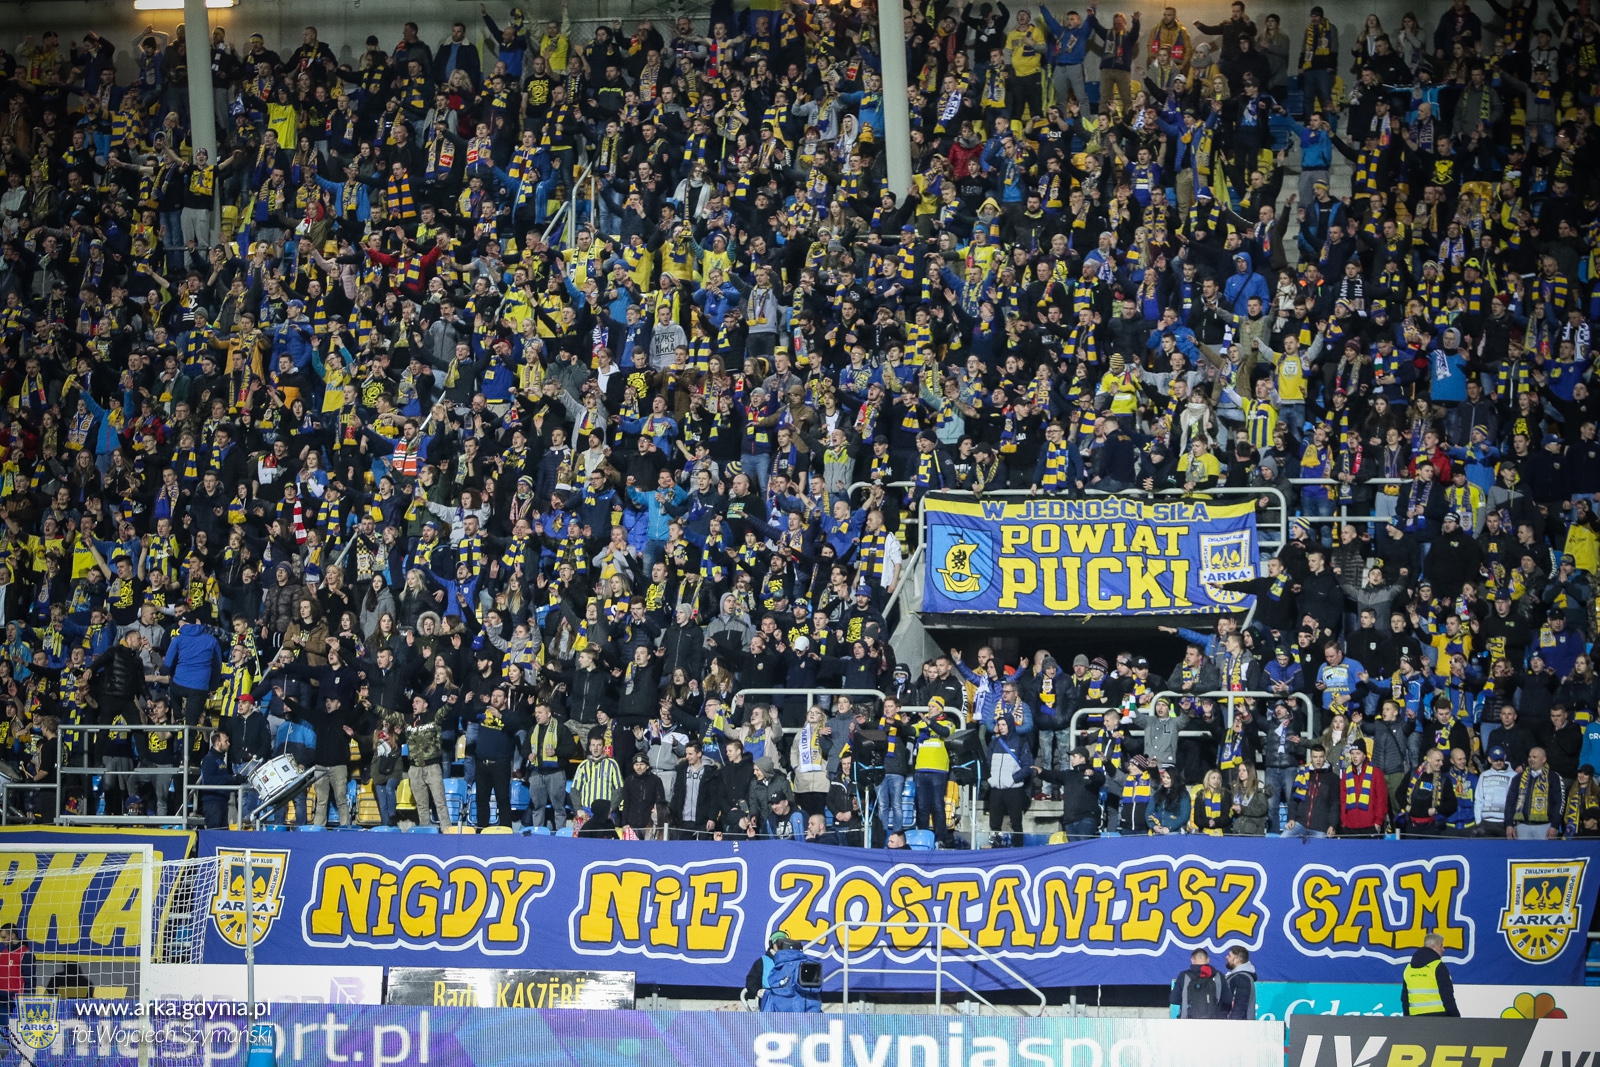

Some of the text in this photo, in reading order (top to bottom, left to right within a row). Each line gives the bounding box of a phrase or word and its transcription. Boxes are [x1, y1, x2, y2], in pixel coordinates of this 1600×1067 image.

[982, 495, 1211, 522] W JEDNOŚCI SIŁA
[1000, 522, 1189, 556] POWIAT
[998, 557, 1192, 610] PUCKI
[1207, 571, 1247, 581] ARKA
[1295, 867, 1464, 950] SAM
[1513, 915, 1566, 925] ARKA
